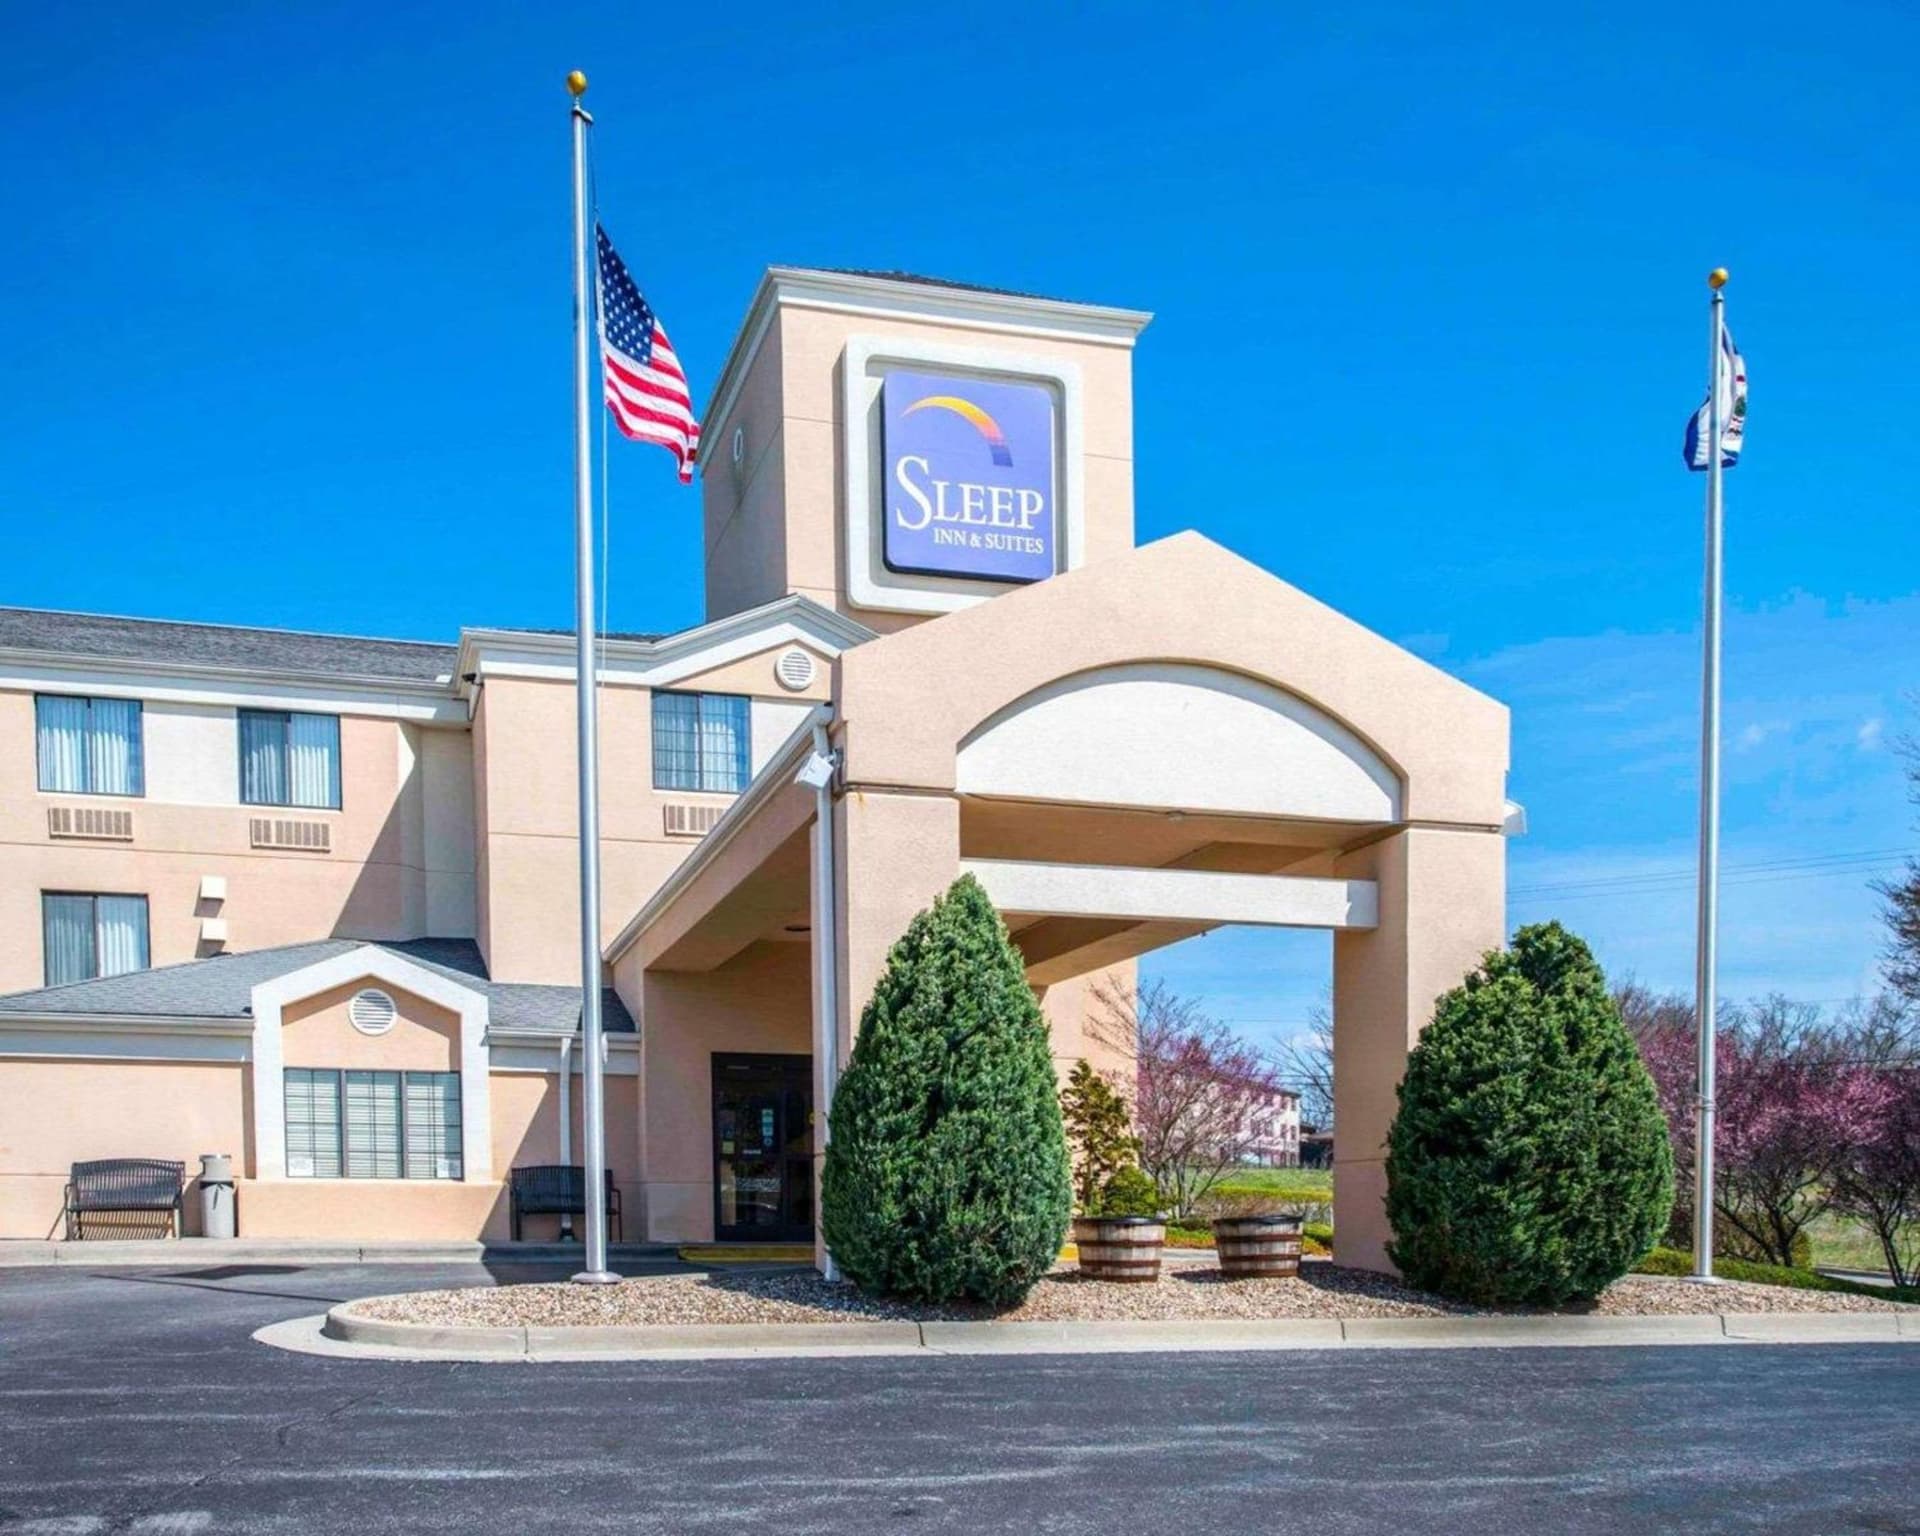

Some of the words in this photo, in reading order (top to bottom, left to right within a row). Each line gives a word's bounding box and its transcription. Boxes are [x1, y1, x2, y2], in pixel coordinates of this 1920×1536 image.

[896, 455, 1044, 530] SLEEP
[934, 528, 966, 546] INN
[970, 533, 982, 548] &
[985, 533, 1044, 554] SUITES
